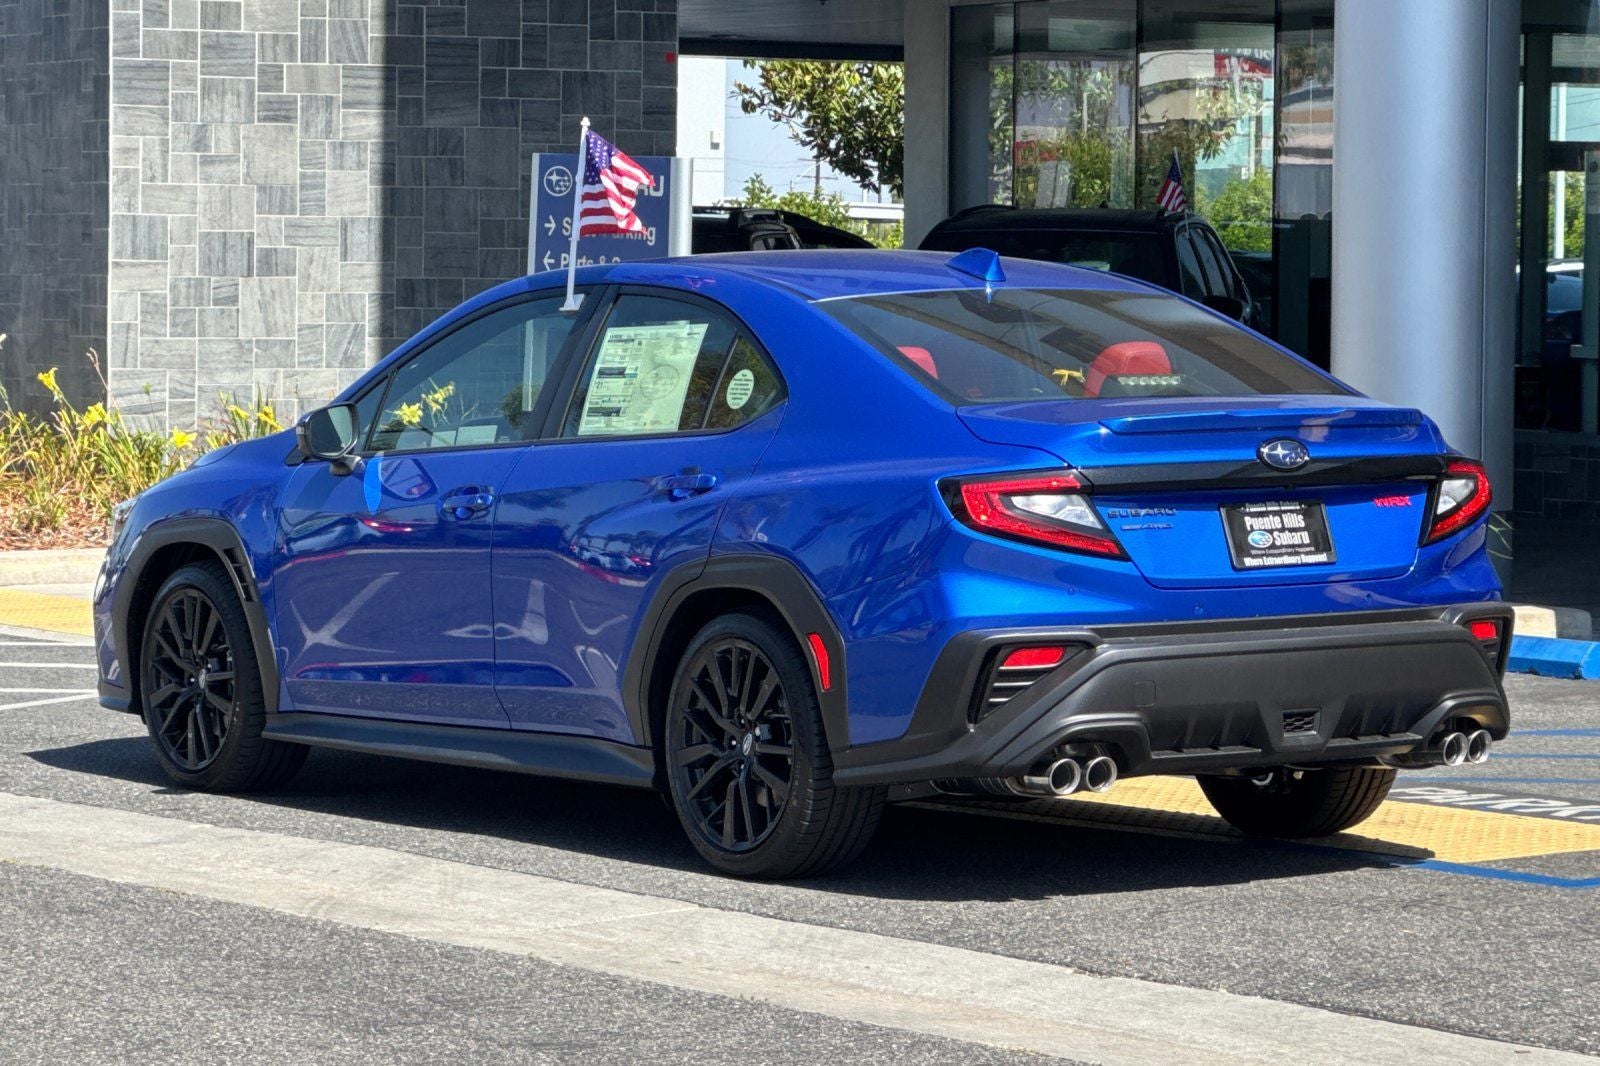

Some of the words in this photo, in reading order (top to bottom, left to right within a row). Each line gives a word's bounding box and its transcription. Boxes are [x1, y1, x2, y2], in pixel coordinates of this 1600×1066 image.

[560, 253, 594, 268] Prts
[1107, 508, 1176, 518] SUBARU
[1244, 514, 1282, 531] Puente
[1282, 512, 1305, 528] Hills
[1273, 530, 1311, 546] Subaru
